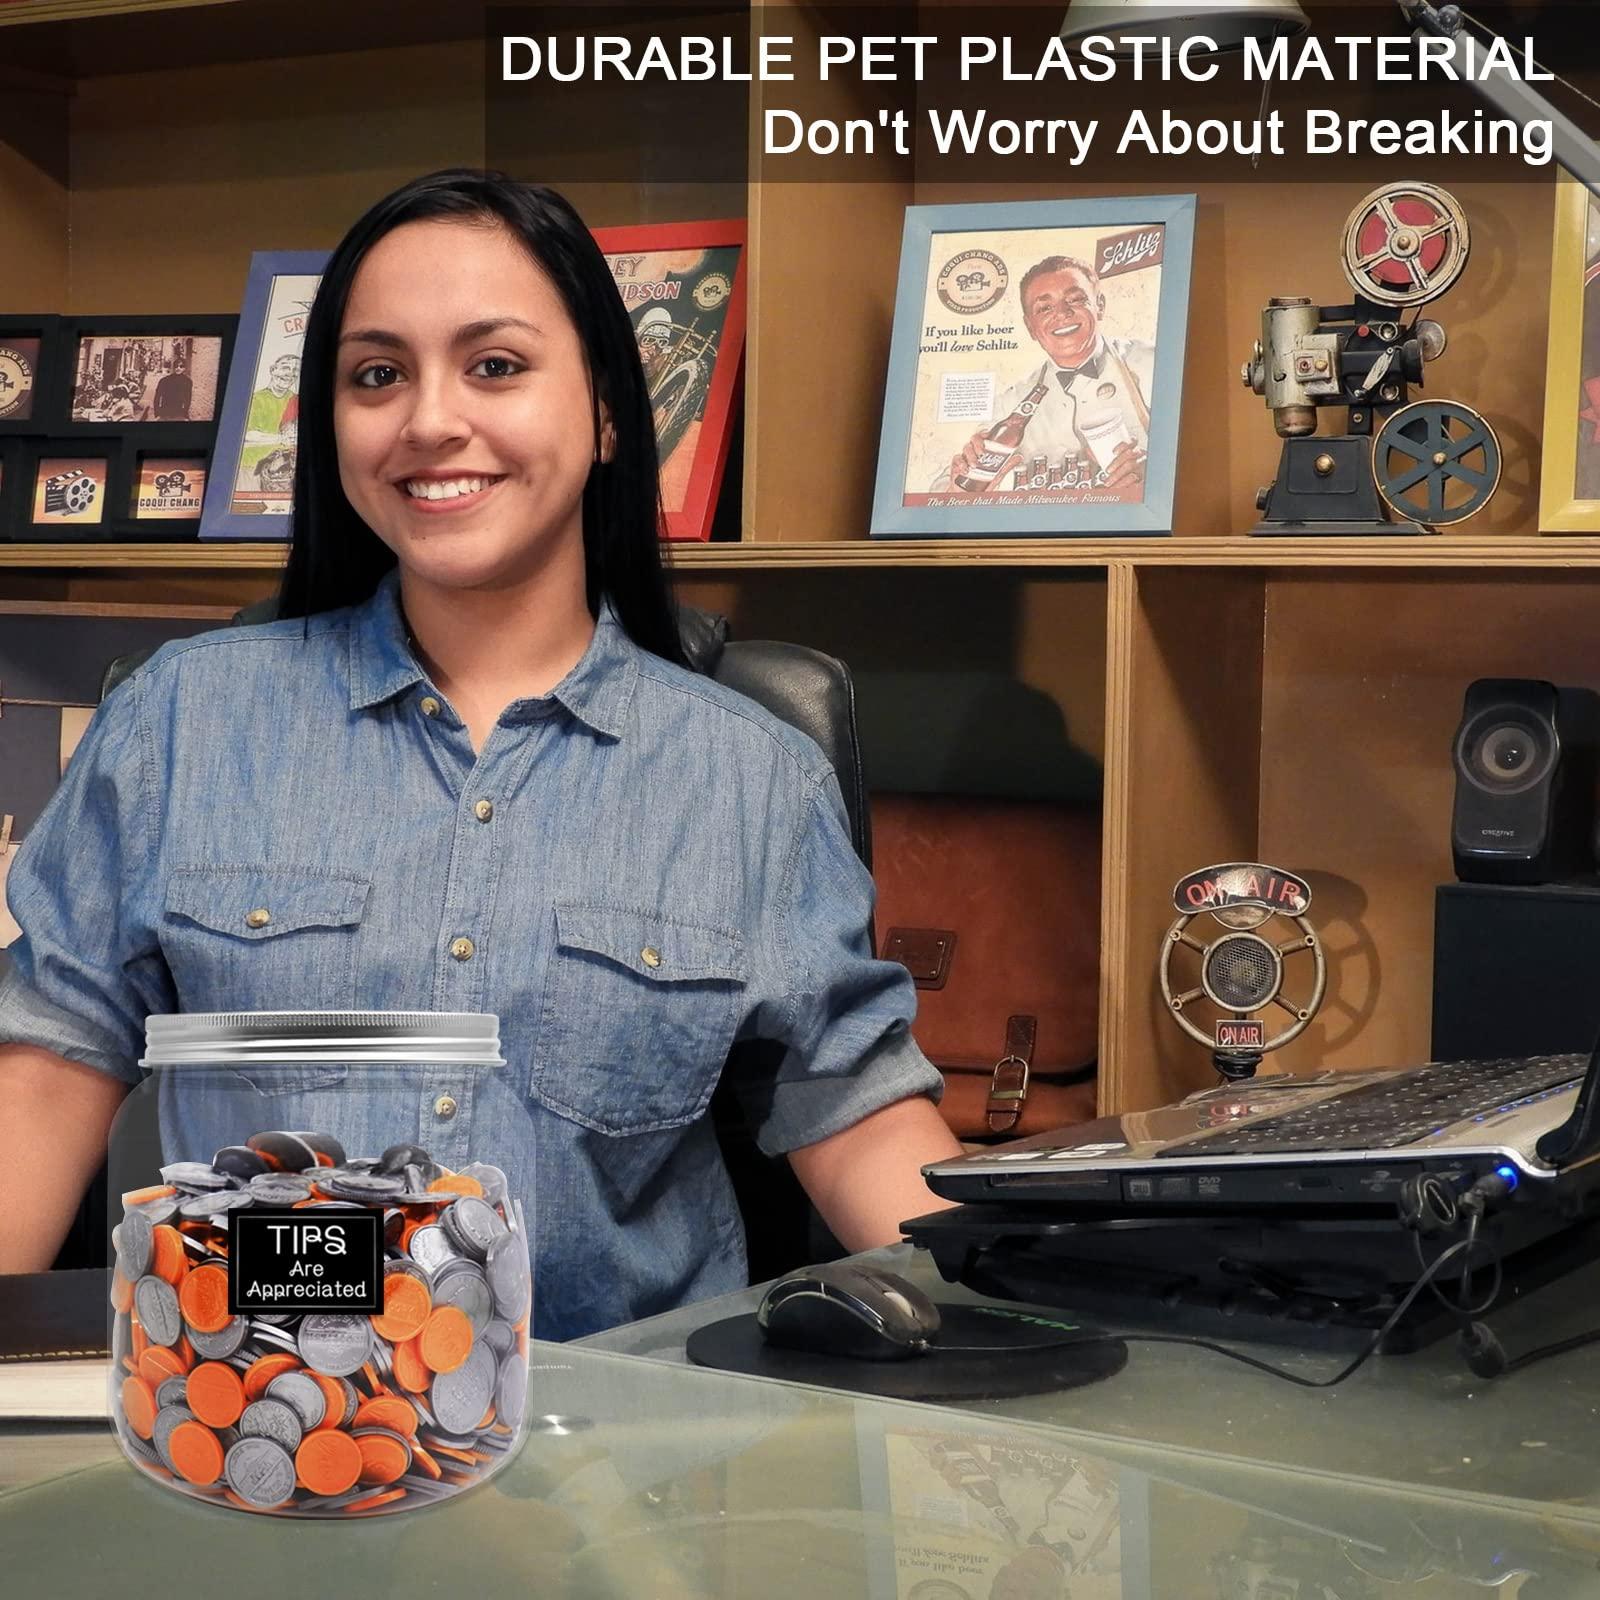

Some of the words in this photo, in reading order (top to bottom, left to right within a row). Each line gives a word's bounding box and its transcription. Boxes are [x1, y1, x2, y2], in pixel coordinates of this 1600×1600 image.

[1100, 232, 1160, 273] Schlitz
[925, 326, 936, 337] If
[936, 329, 958, 339] you
[961, 324, 984, 336] like
[987, 324, 1014, 335] beer
[950, 341, 974, 352] love
[976, 339, 1019, 351] Schlitz
[139, 498, 167, 507] COQUI
[170, 497, 200, 507] CHANG
[1186, 877, 1222, 906] ON
[1245, 874, 1301, 906] AIR
[1220, 1026, 1237, 1044] ON
[1239, 1026, 1259, 1044] AIR
[267, 1225, 347, 1255] TIPS
[289, 1260, 324, 1277] Are
[246, 1280, 367, 1301] Appreciated
